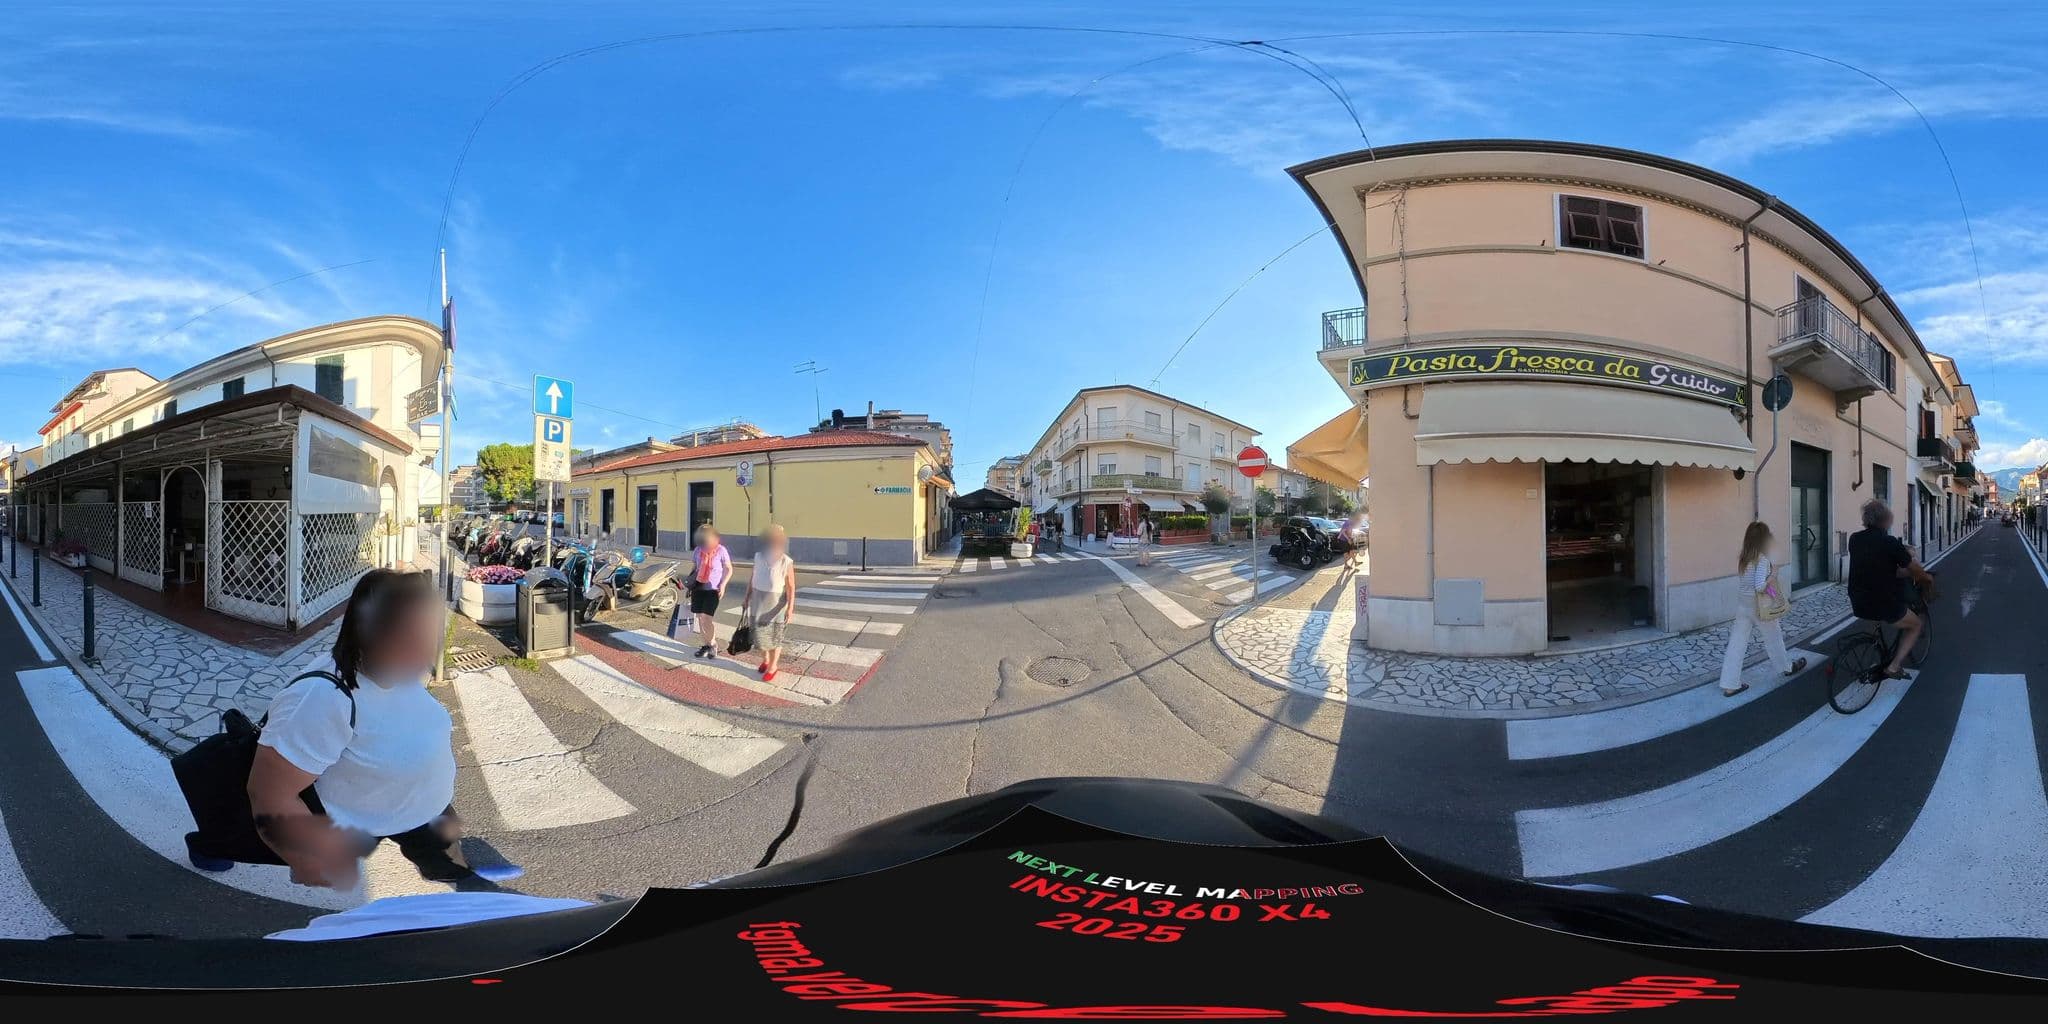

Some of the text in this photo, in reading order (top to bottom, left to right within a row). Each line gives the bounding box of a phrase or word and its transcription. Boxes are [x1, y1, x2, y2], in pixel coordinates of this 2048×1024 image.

[1383, 347, 1726, 395] Pasta fresca da Guido
[548, 421, 562, 440] P
